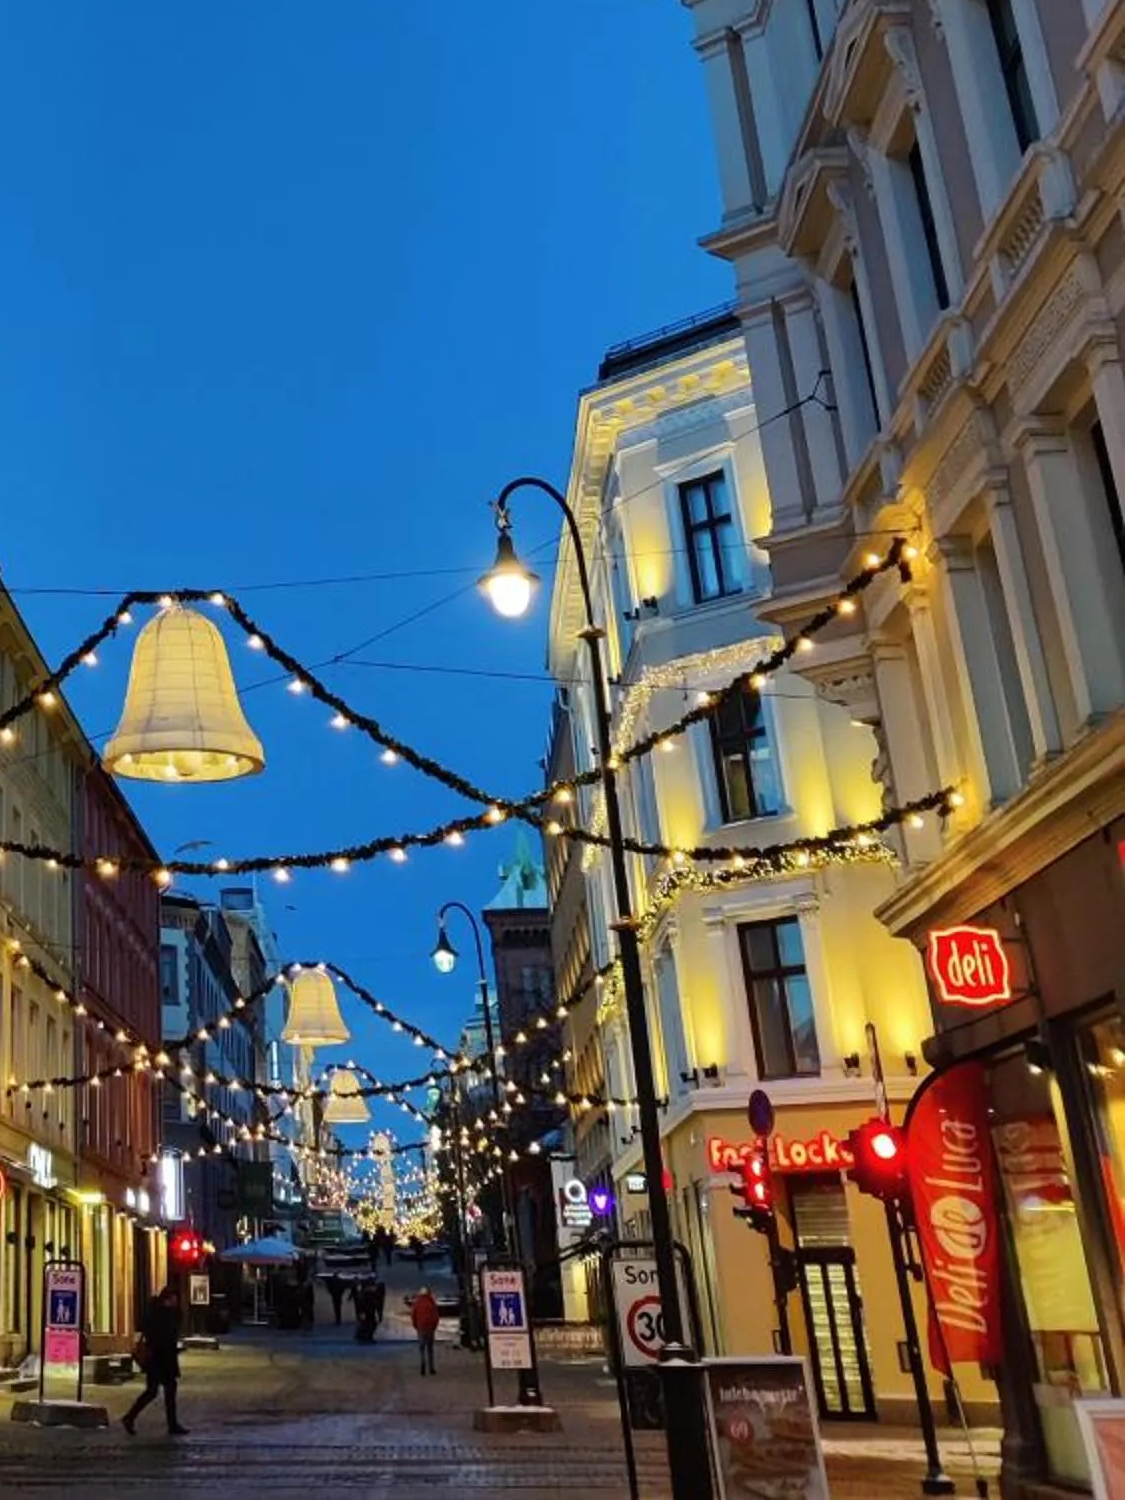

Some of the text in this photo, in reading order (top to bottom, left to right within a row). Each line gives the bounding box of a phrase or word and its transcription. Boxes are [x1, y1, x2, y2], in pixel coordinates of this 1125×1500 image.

[947, 940, 995, 987] deli
[925, 1119, 987, 1333] Deli de Luca
